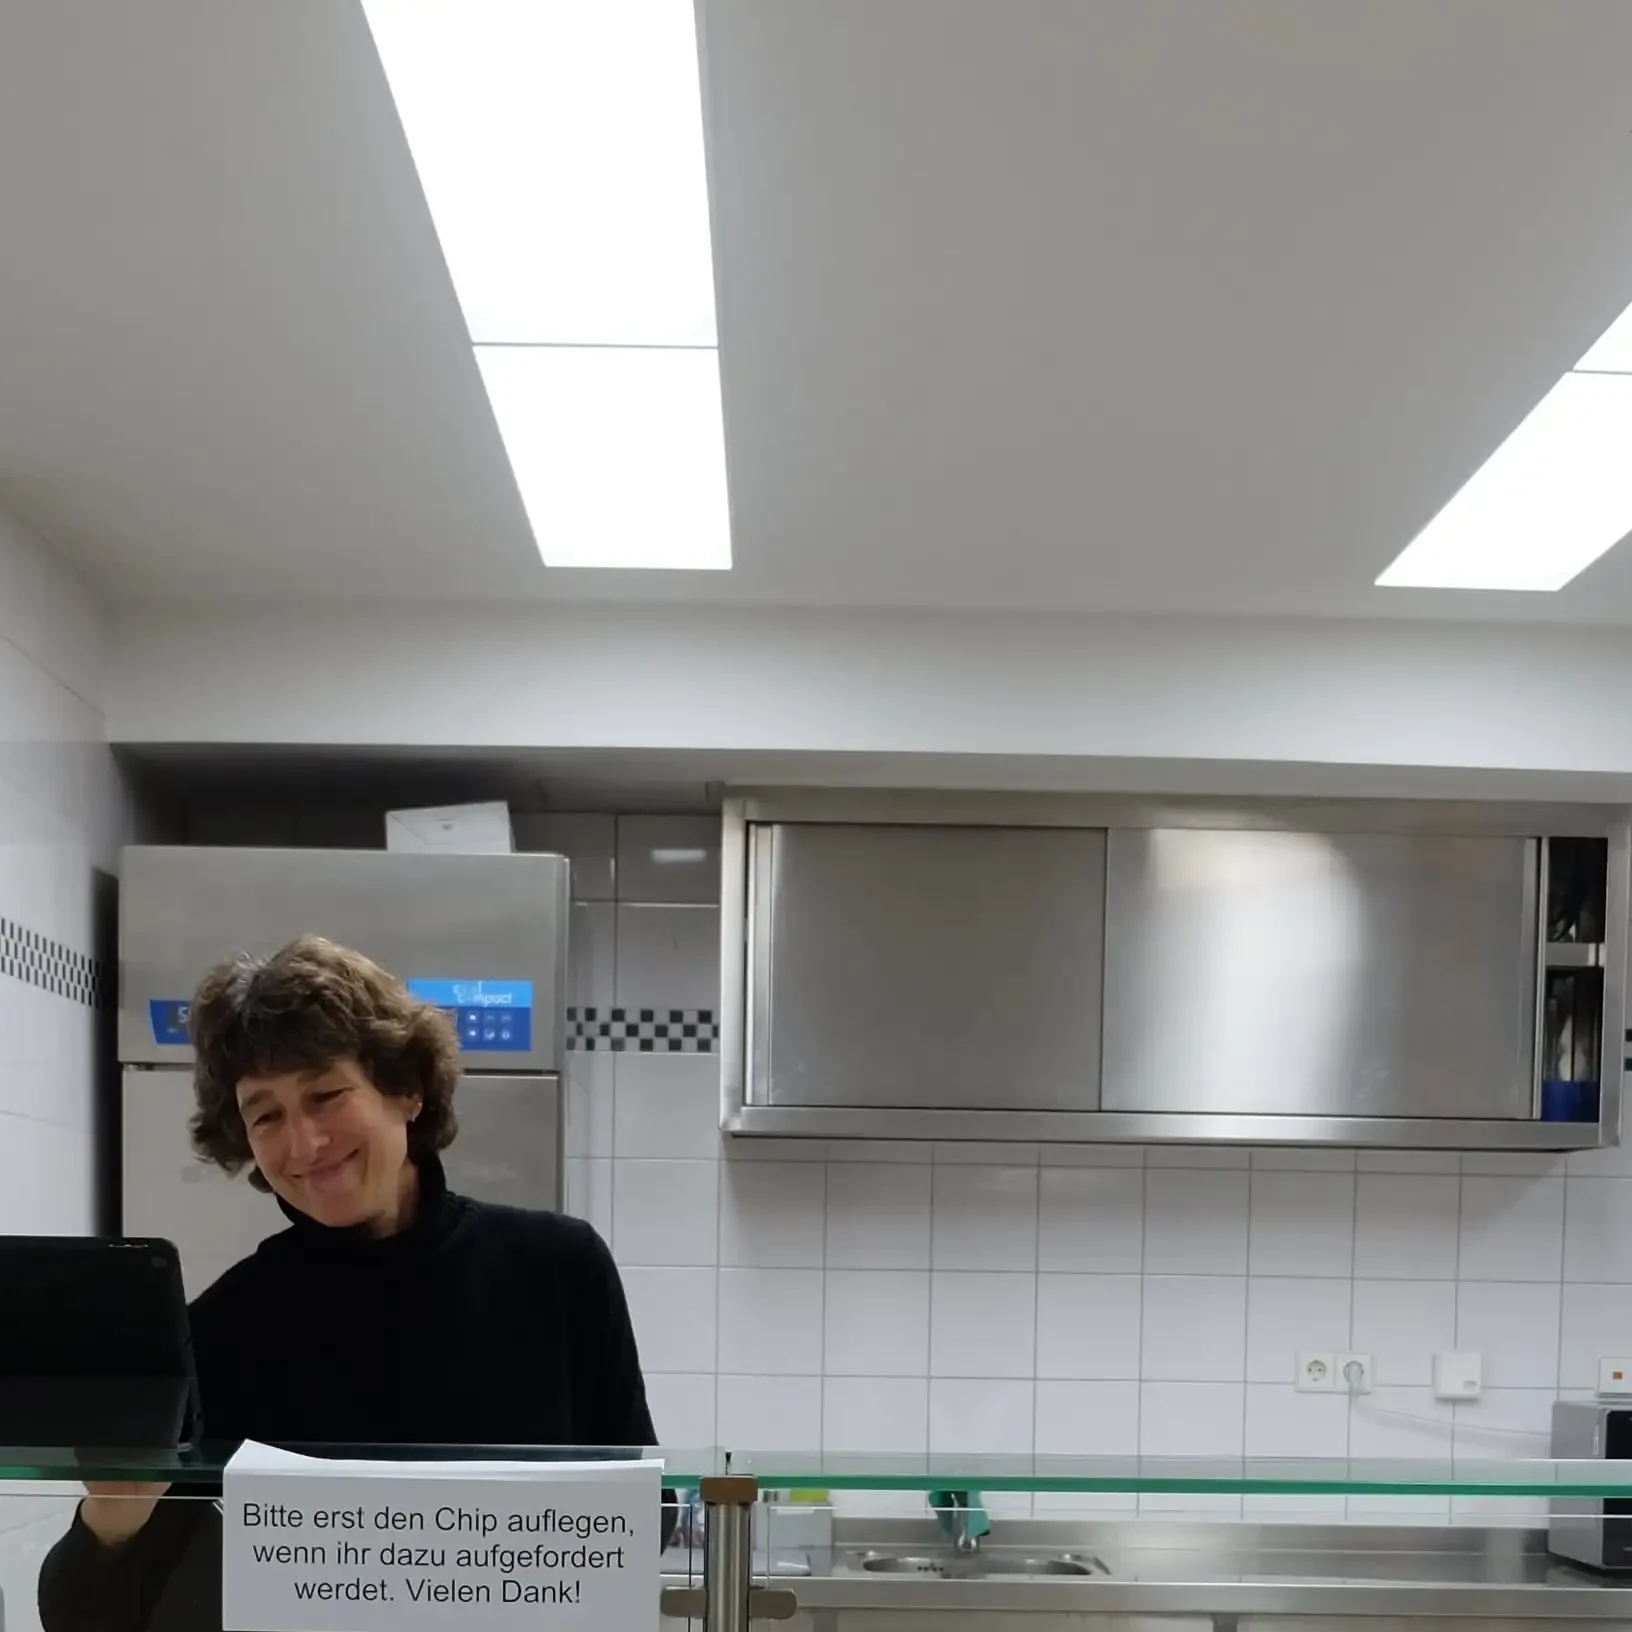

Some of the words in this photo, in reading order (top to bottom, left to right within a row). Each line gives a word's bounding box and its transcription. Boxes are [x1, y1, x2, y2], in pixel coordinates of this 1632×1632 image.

[242, 1501, 304, 1529] Bitte
[313, 1506, 365, 1530] erst
[374, 1505, 426, 1531] den
[434, 1506, 498, 1536] Chip
[507, 1508, 635, 1537] auflegen,
[252, 1544, 327, 1565] wenn
[336, 1541, 372, 1566] ihr
[379, 1542, 446, 1568] dazu
[455, 1544, 625, 1574] aufgefordert
[294, 1578, 395, 1602] werdet.
[404, 1577, 492, 1604] Vielen
[501, 1579, 582, 1605] Dank!
